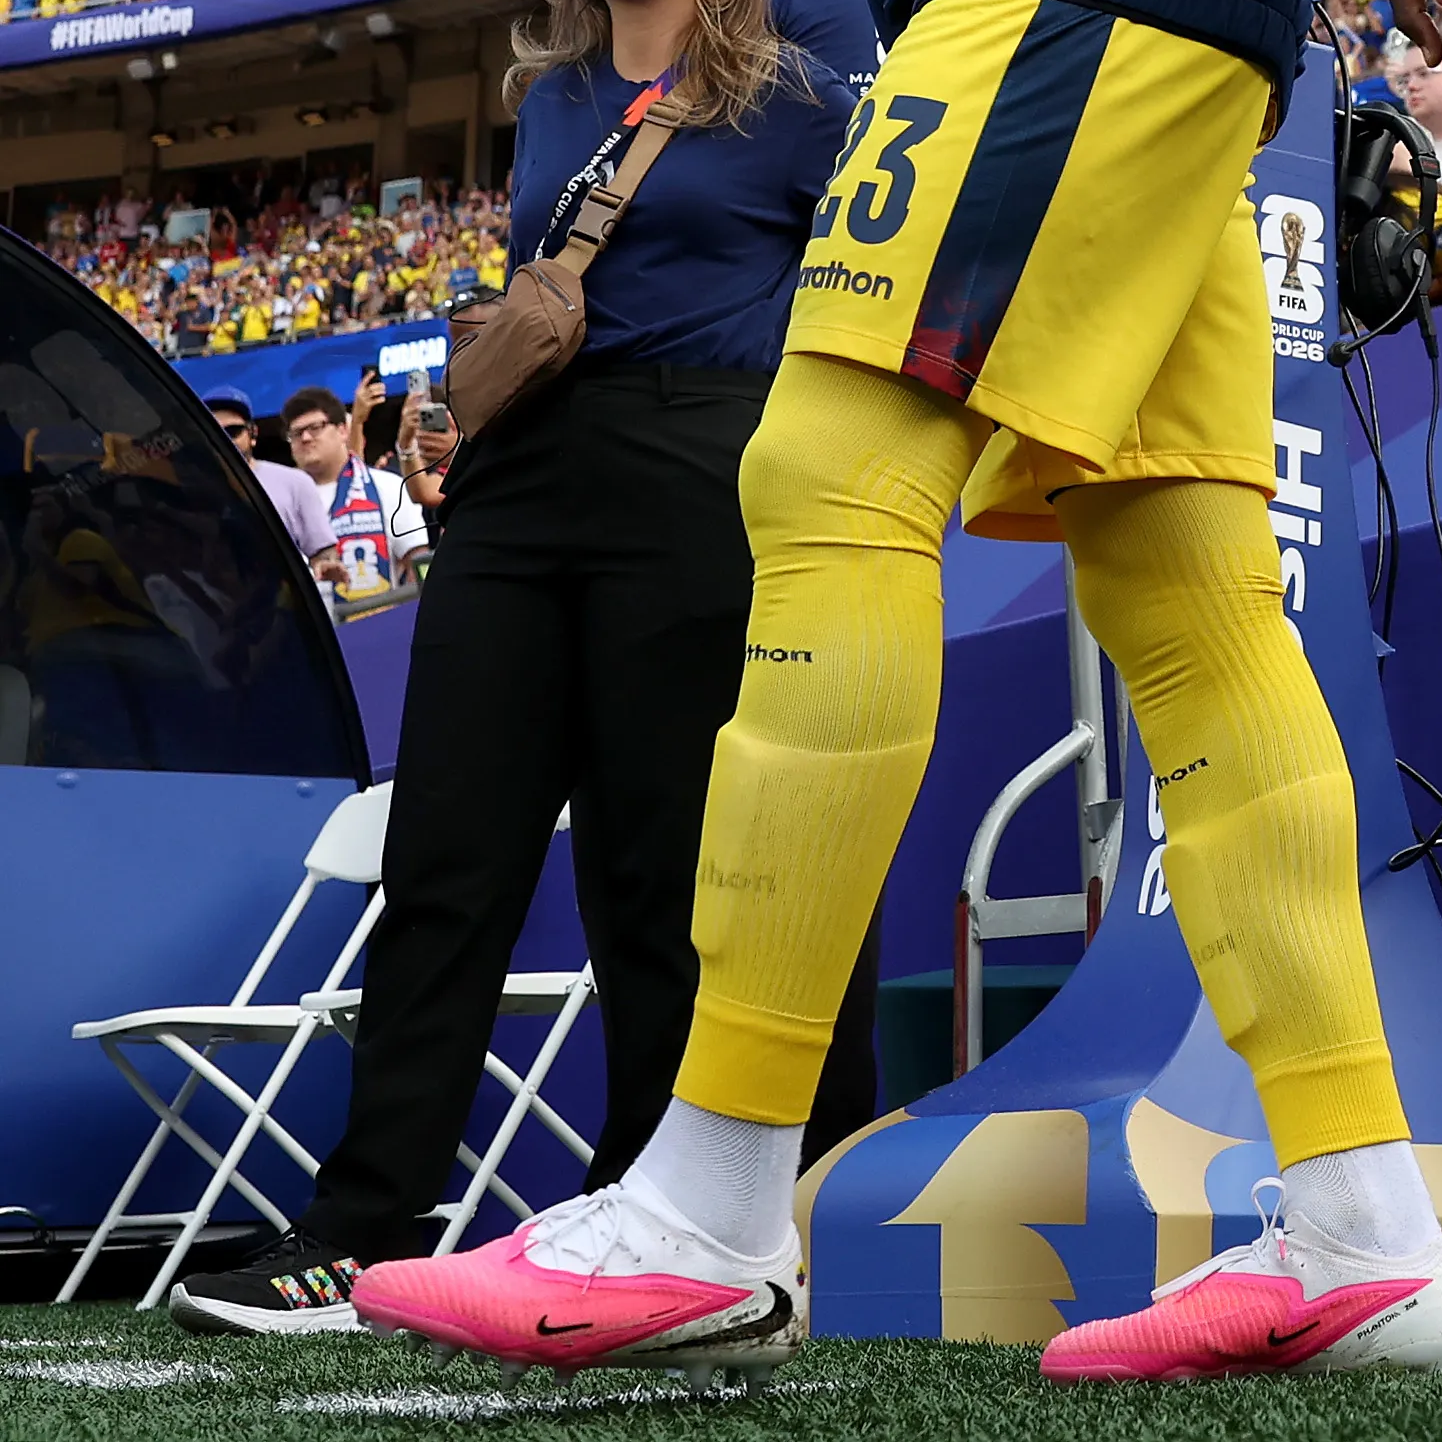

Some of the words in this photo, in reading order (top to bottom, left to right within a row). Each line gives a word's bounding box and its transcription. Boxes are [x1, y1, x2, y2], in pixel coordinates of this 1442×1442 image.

[51, 6, 195, 51] #FIFAWorldCup
[811, 95, 949, 245] 23
[554, 192, 573, 219] CUP
[1278, 294, 1307, 312] FIFA
[1301, 328, 1324, 342] CUP
[1271, 337, 1325, 362] 026
